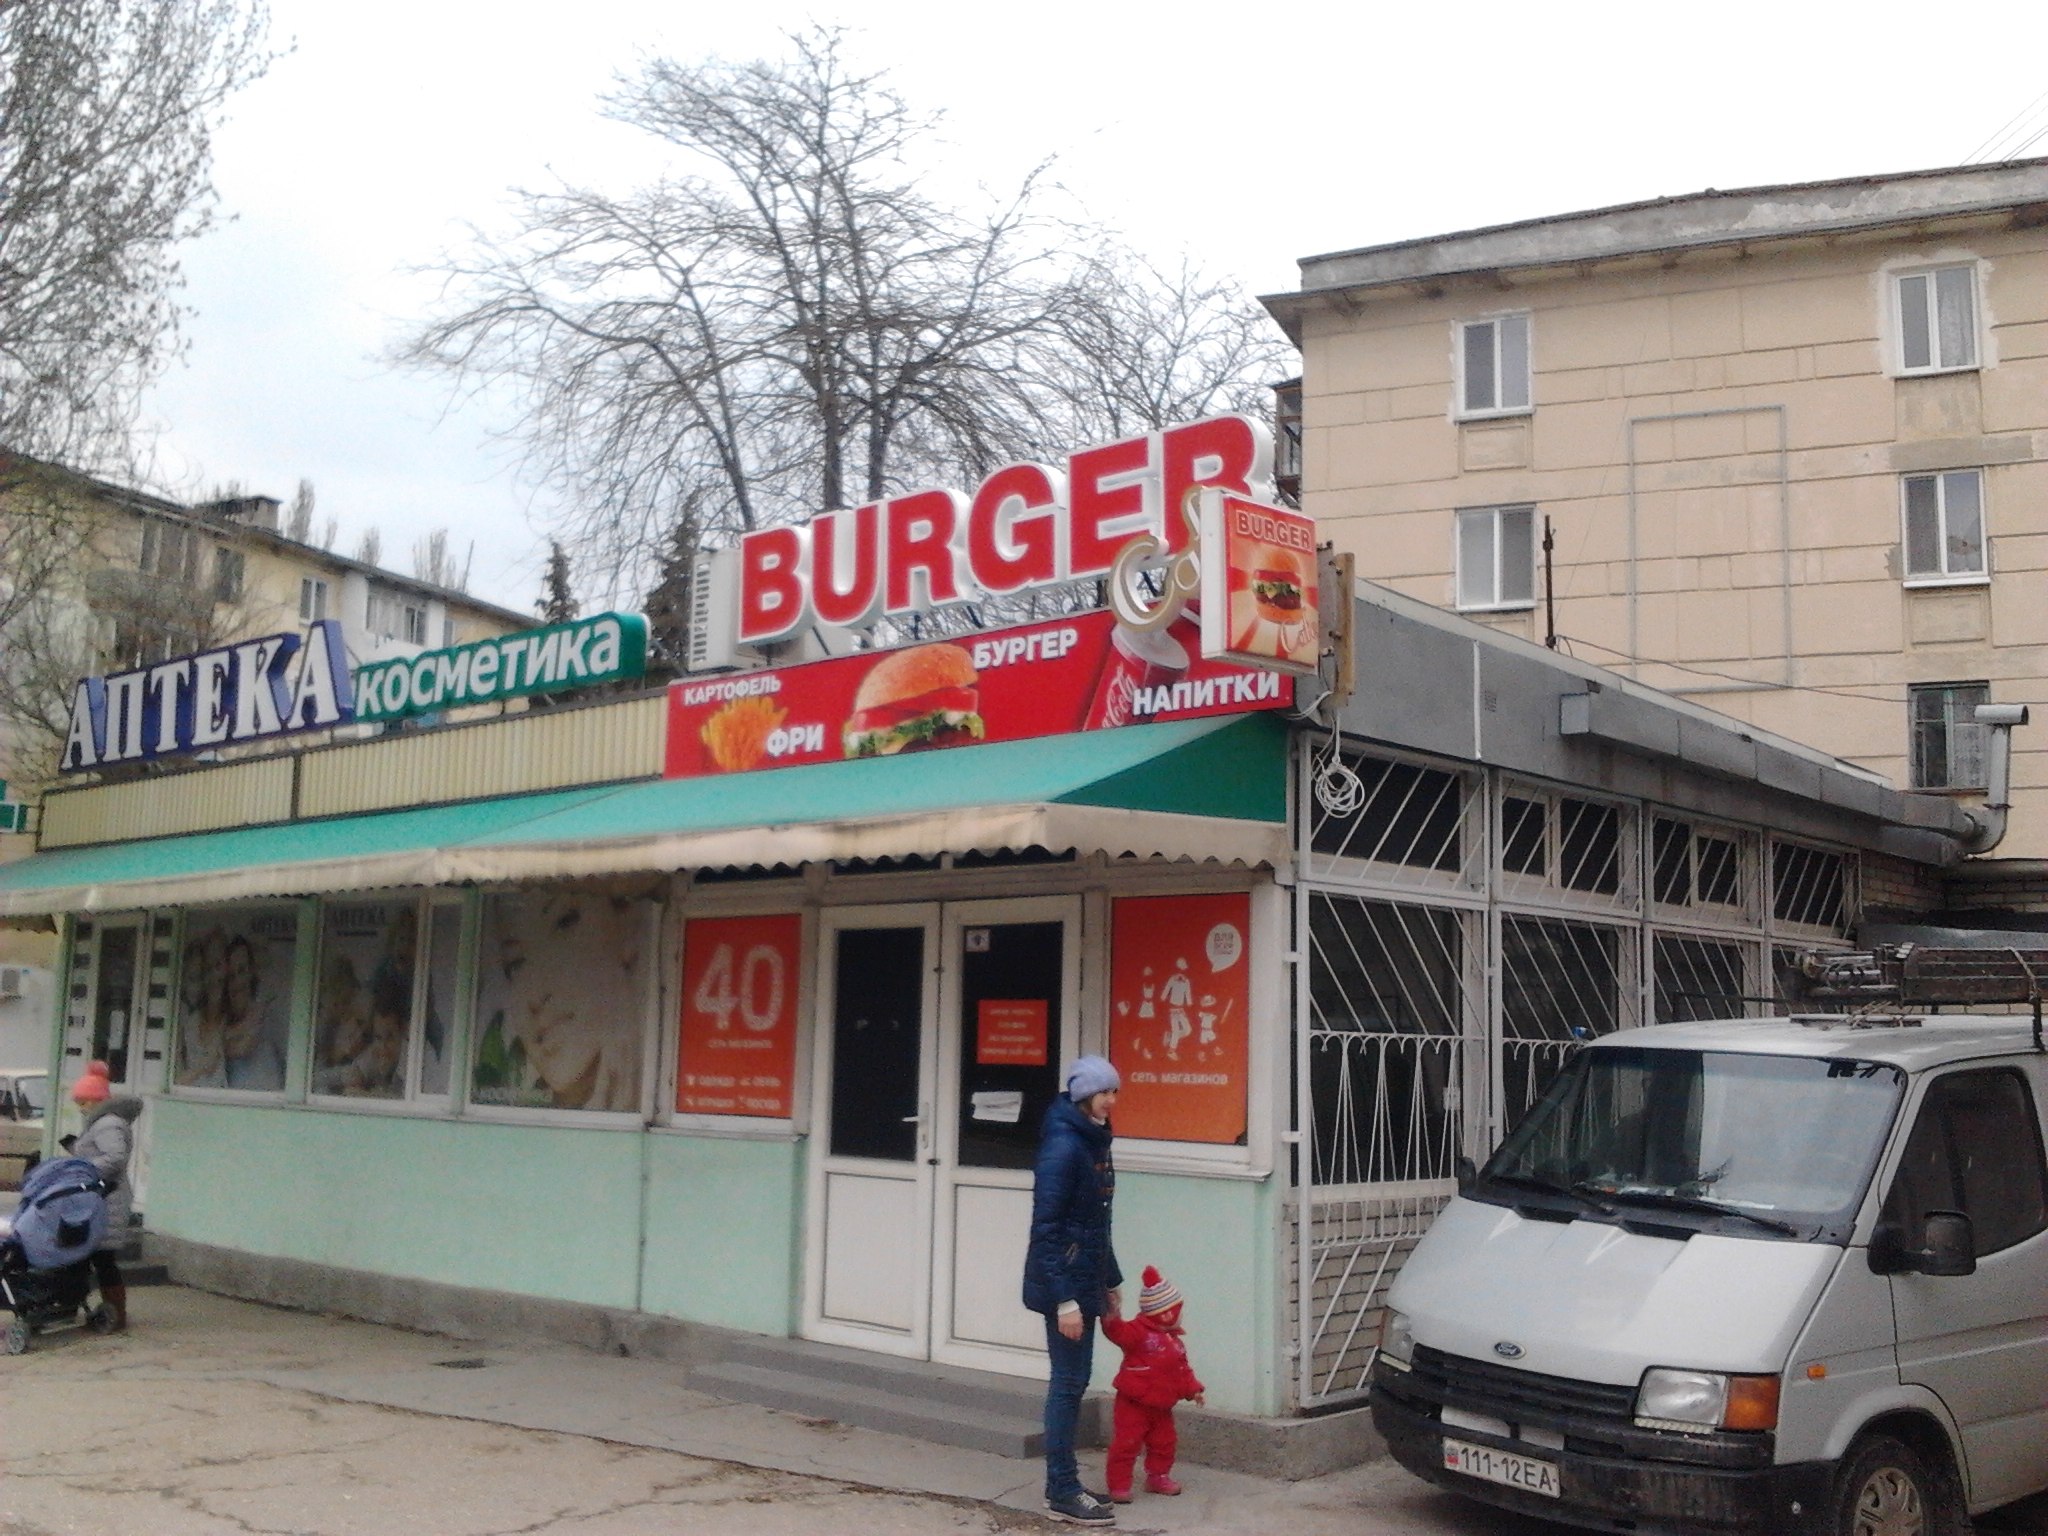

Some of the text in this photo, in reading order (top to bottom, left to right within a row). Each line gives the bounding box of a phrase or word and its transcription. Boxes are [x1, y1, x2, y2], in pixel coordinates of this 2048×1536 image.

[739, 415, 1264, 643] BURGER
[1236, 509, 1313, 552] BURGER
[973, 628, 1077, 670] БУРГЕР
[60, 620, 341, 771] АПТЕКА
[684, 675, 781, 706] КАРТОФЕЛЬ
[1132, 672, 1280, 716] НАПИТКИ
[767, 723, 825, 756] ФРИ
[696, 944, 783, 1031] 40
[1461, 1447, 1553, 1491] 111-12EA
